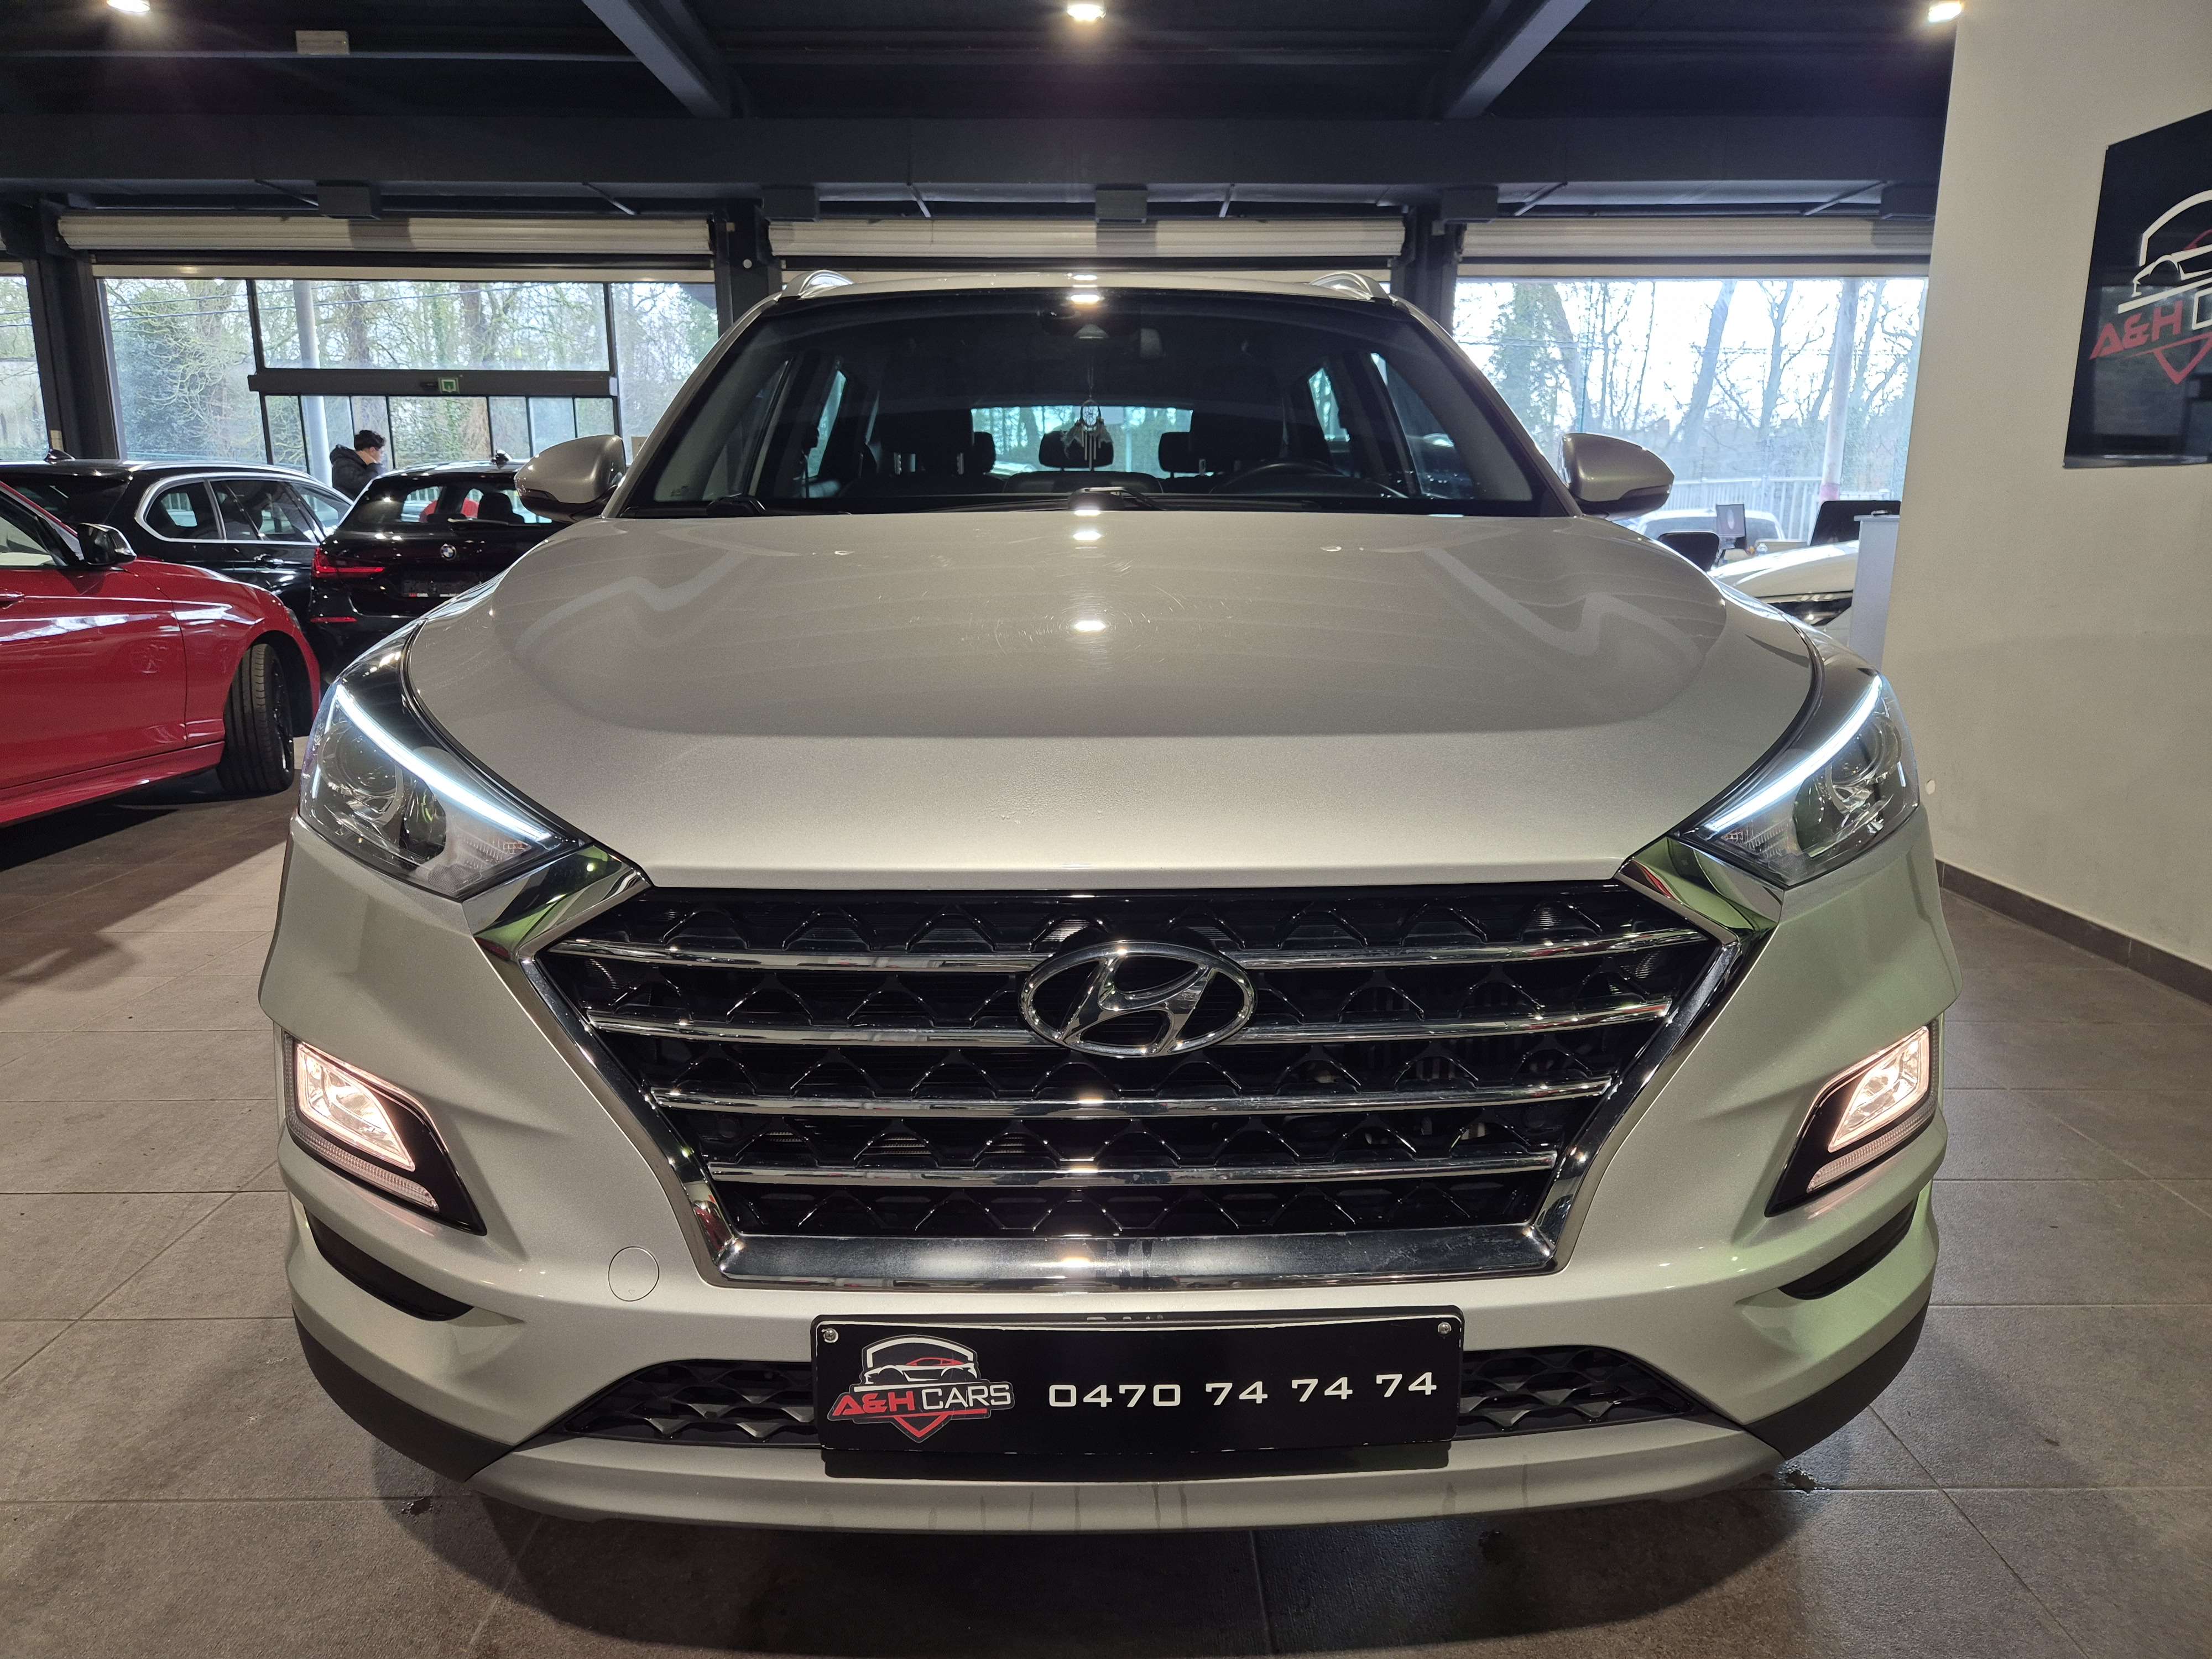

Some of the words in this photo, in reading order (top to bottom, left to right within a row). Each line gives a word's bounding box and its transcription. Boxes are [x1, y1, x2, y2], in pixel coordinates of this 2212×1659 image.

[2089, 300, 2183, 360] A&H
[832, 1391, 915, 1416] A&H
[921, 1384, 1011, 1410] CARS
[1049, 1385, 1180, 1407] 0470
[1206, 1381, 1267, 1405] 74
[1292, 1377, 1353, 1402] 74
[1376, 1372, 1436, 1397] 74
